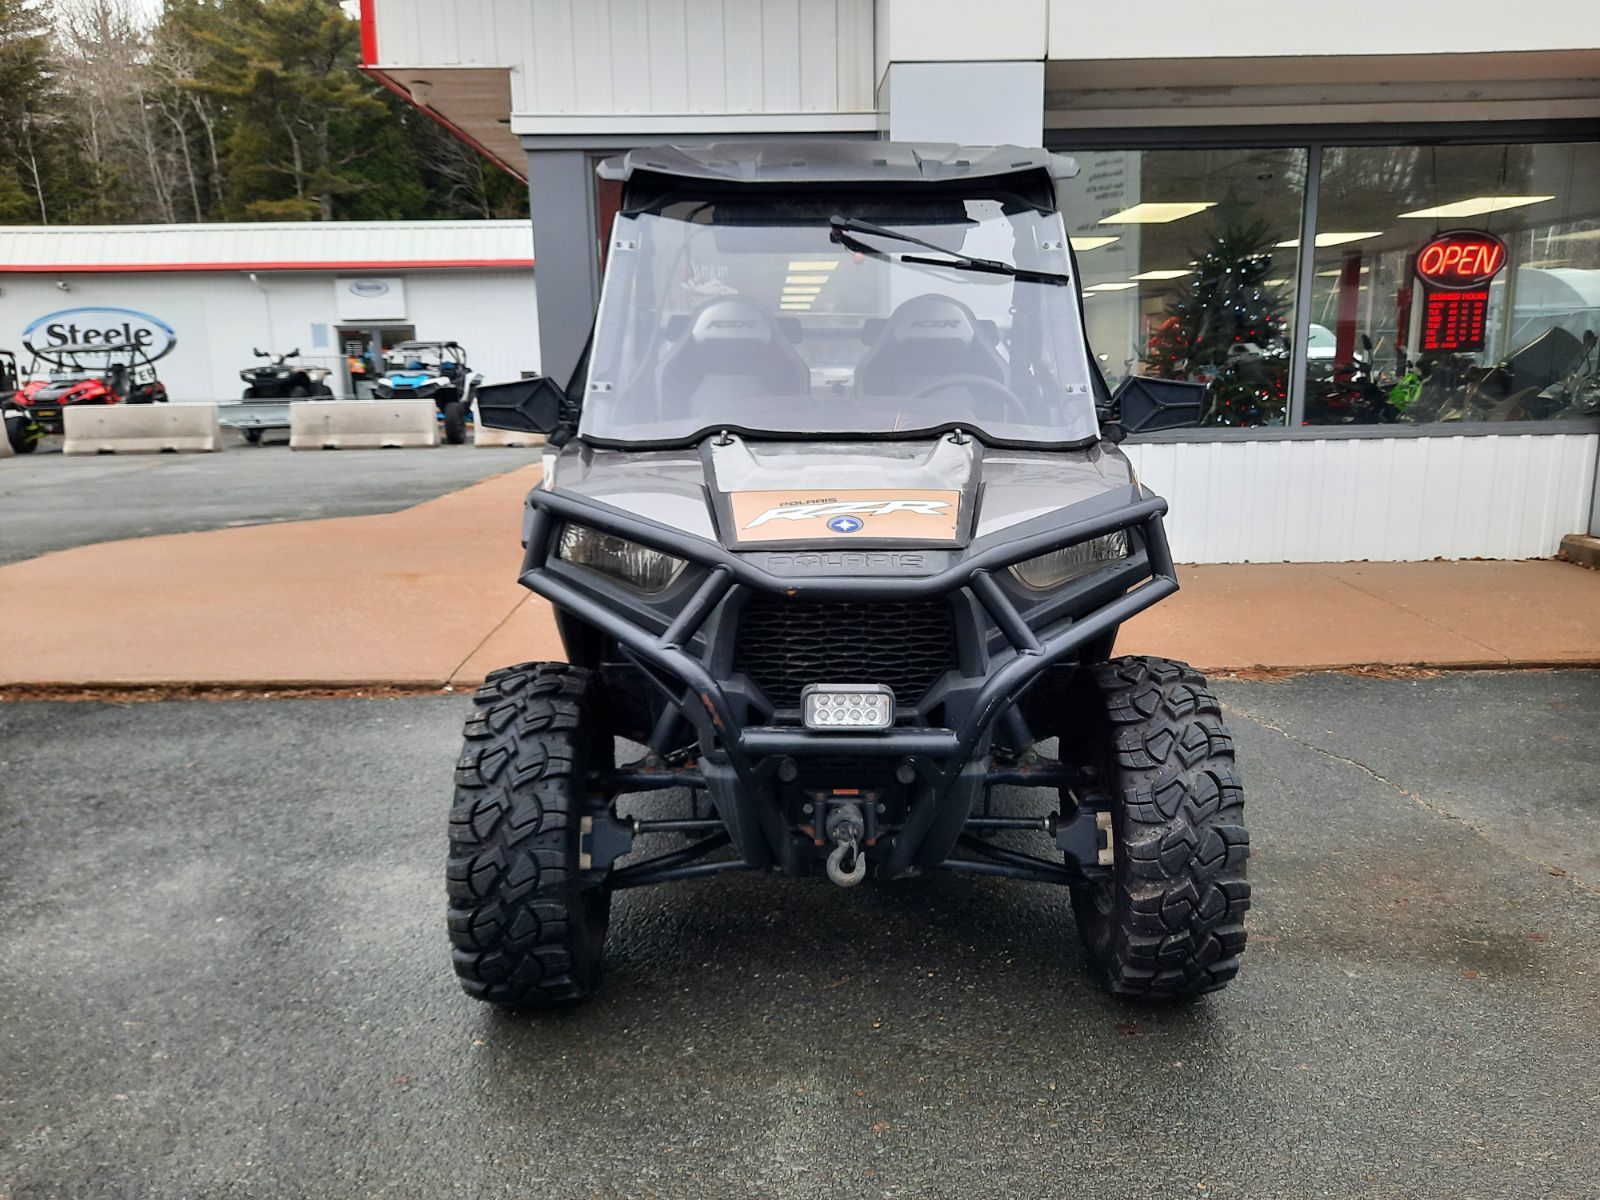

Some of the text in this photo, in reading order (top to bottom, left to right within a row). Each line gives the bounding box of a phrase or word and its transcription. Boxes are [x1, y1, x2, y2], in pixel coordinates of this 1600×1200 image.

[1421, 245, 1499, 275] OPEN
[46, 323, 152, 347] Steele
[779, 497, 838, 507] POLARIS
[743, 500, 953, 529] RZR
[766, 554, 926, 570] POLARIS
